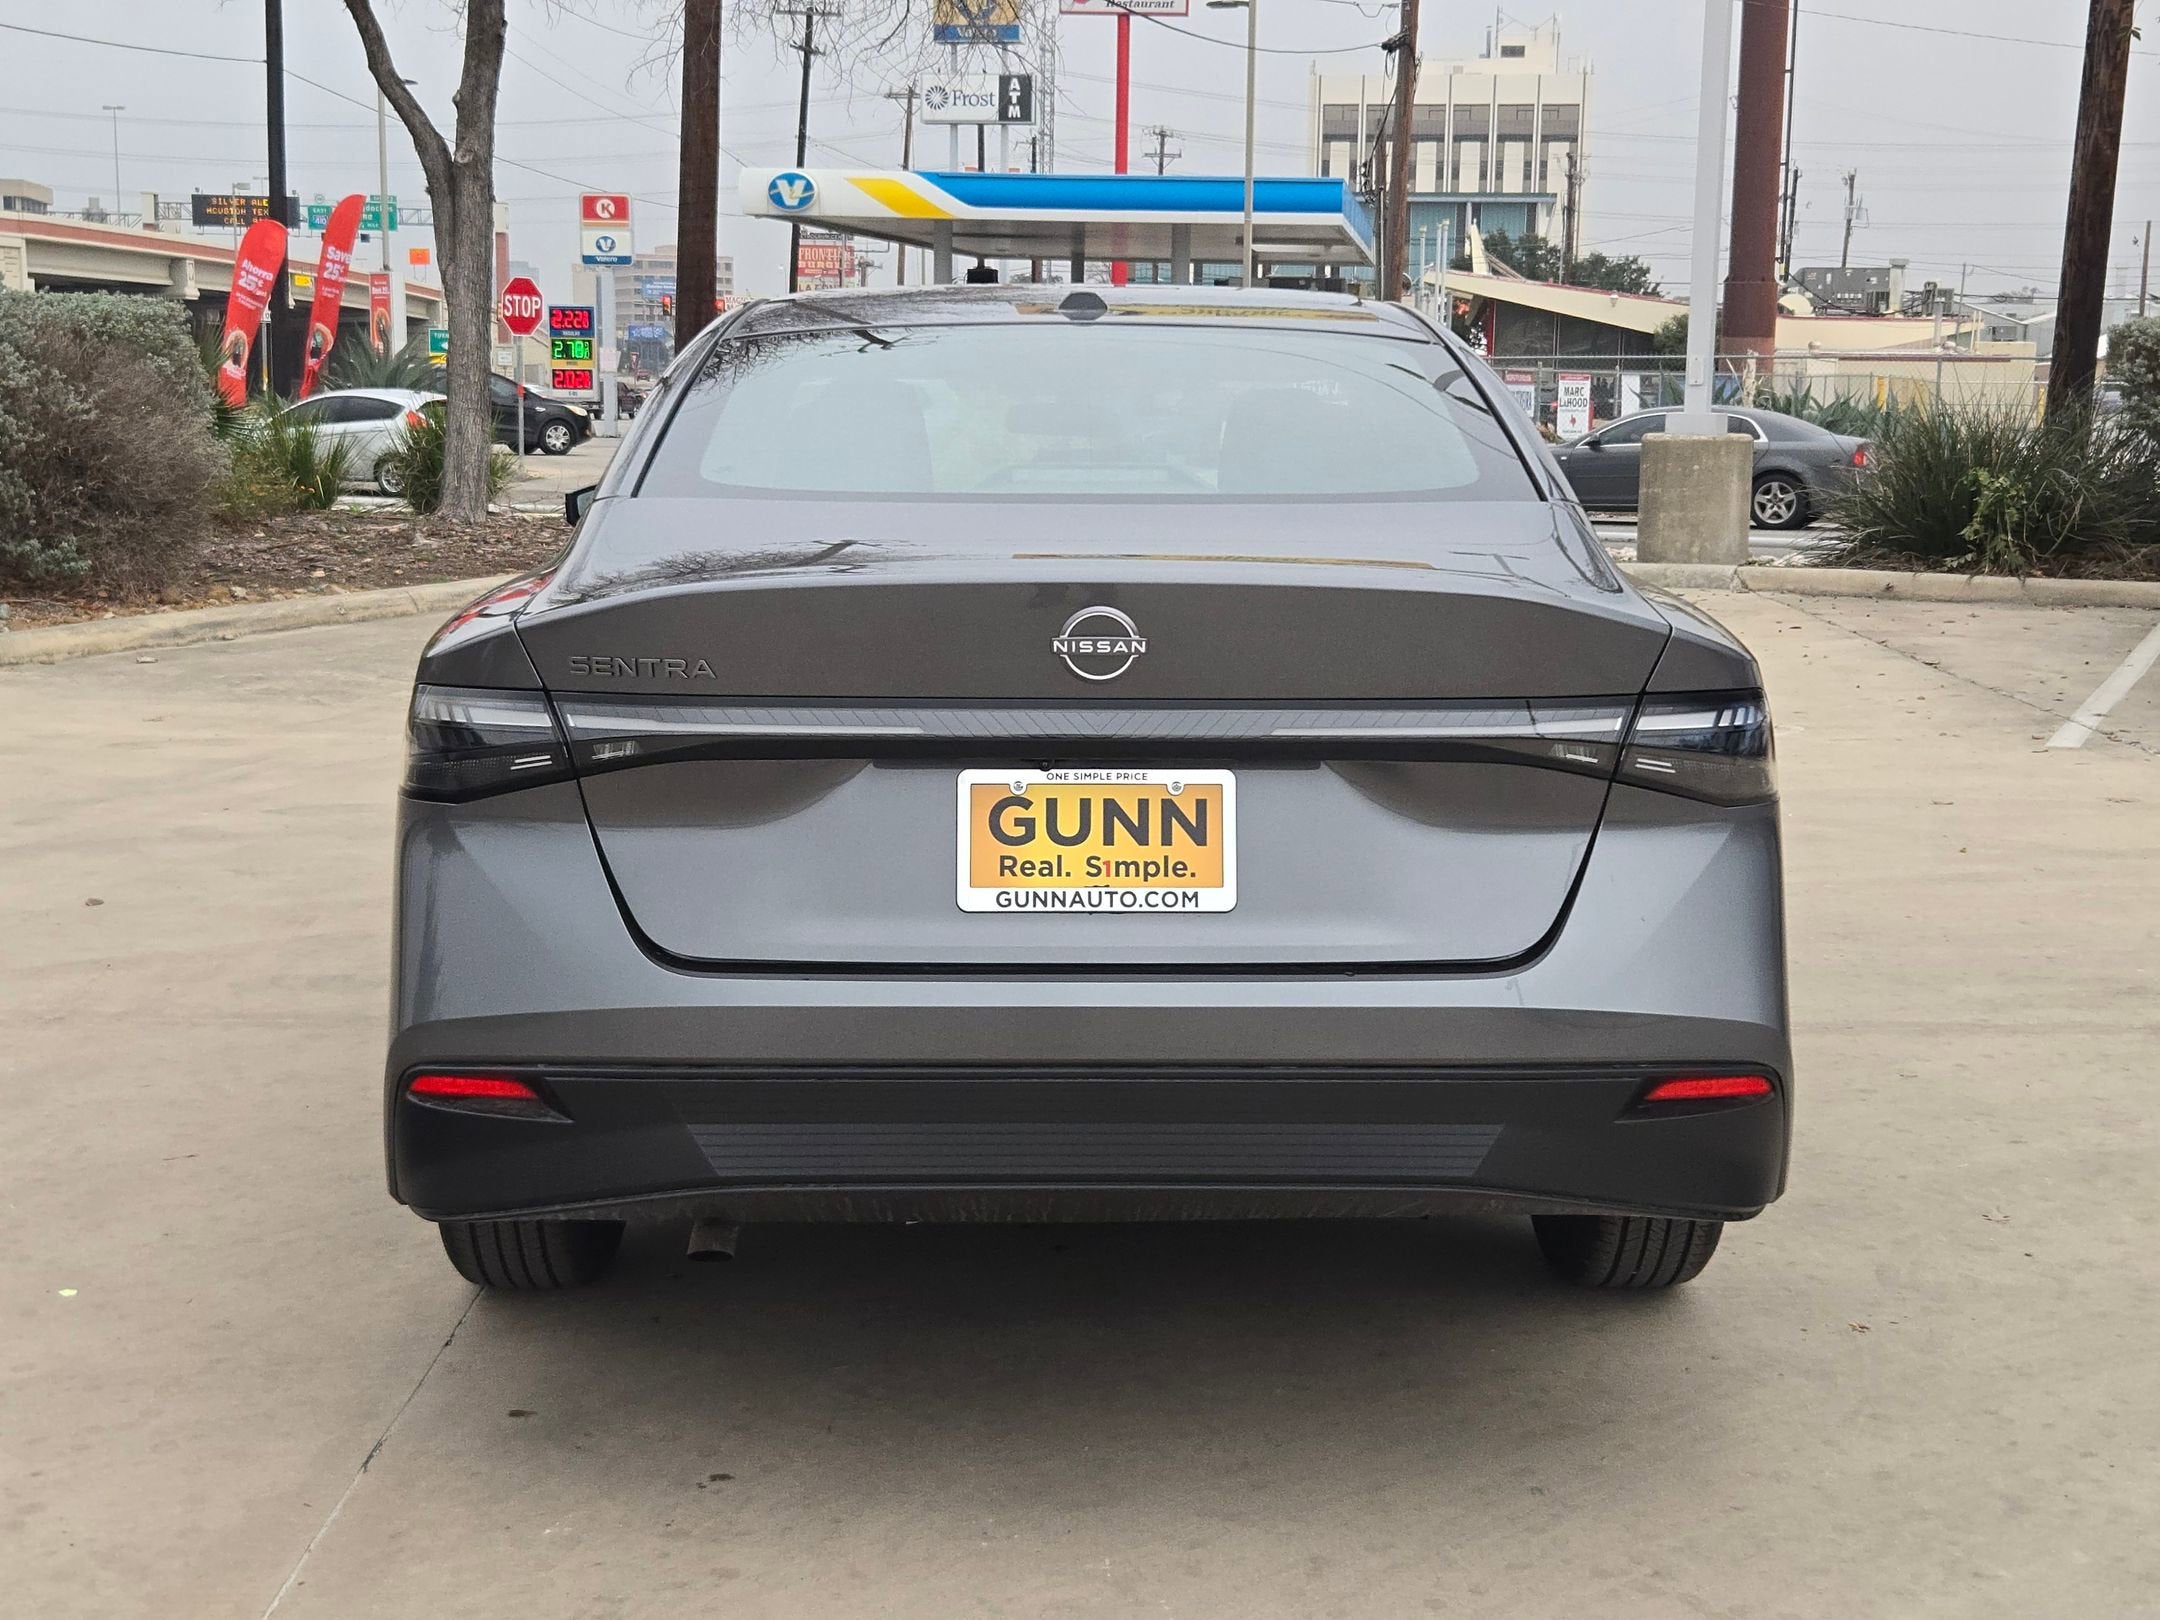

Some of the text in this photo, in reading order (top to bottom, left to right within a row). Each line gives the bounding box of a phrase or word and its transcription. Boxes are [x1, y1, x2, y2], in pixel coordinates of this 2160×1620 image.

[952, 90, 996, 107] Frost
[1008, 78, 1021, 118] ATM
[211, 197, 246, 206] SILVER
[326, 246, 352, 263] Save
[241, 259, 273, 281] Ahorra
[503, 294, 541, 318] STOP
[1563, 386, 1585, 397] MARC
[1053, 640, 1147, 653] NISSAN
[569, 656, 717, 679] SENTRA
[1046, 772, 1148, 781] ONE SIMPLE PRICE
[988, 796, 1207, 847] GUNN
[1000, 855, 1071, 877] Real.
[996, 891, 1199, 908] GUNNAUTO.COM
